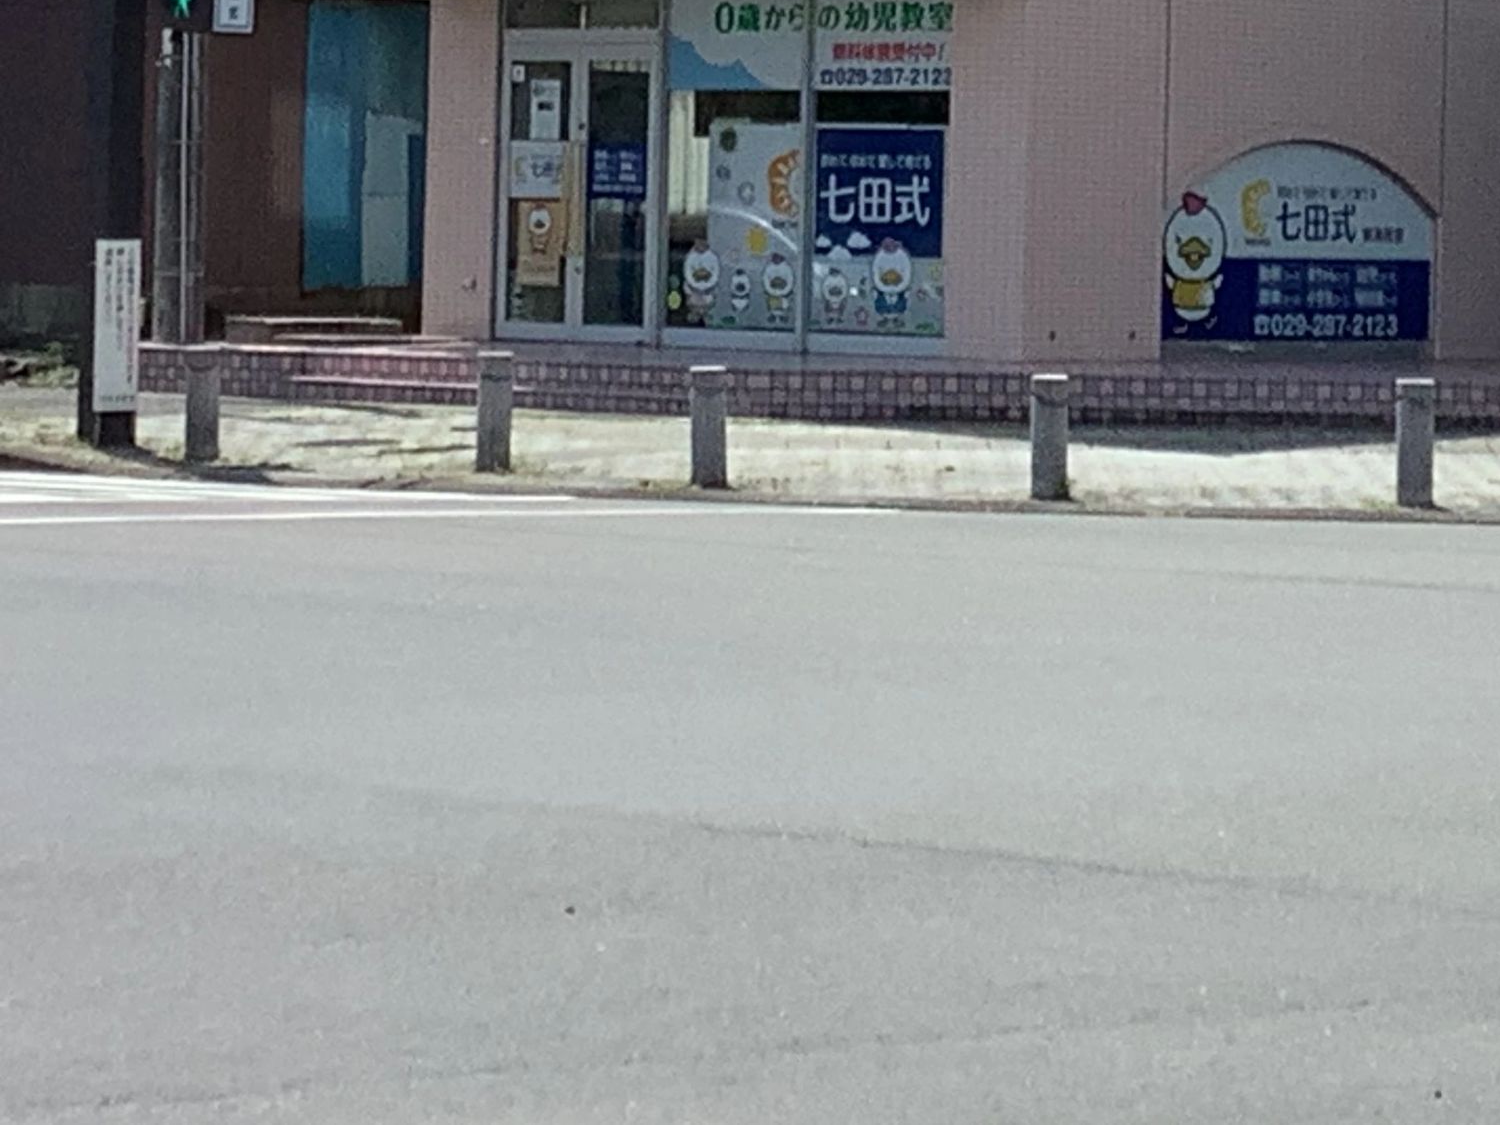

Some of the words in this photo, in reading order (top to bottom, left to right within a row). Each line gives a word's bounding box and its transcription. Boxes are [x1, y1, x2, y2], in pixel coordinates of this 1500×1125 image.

[819, 173, 931, 227] 七田式
[1276, 201, 1357, 243] 七田式
